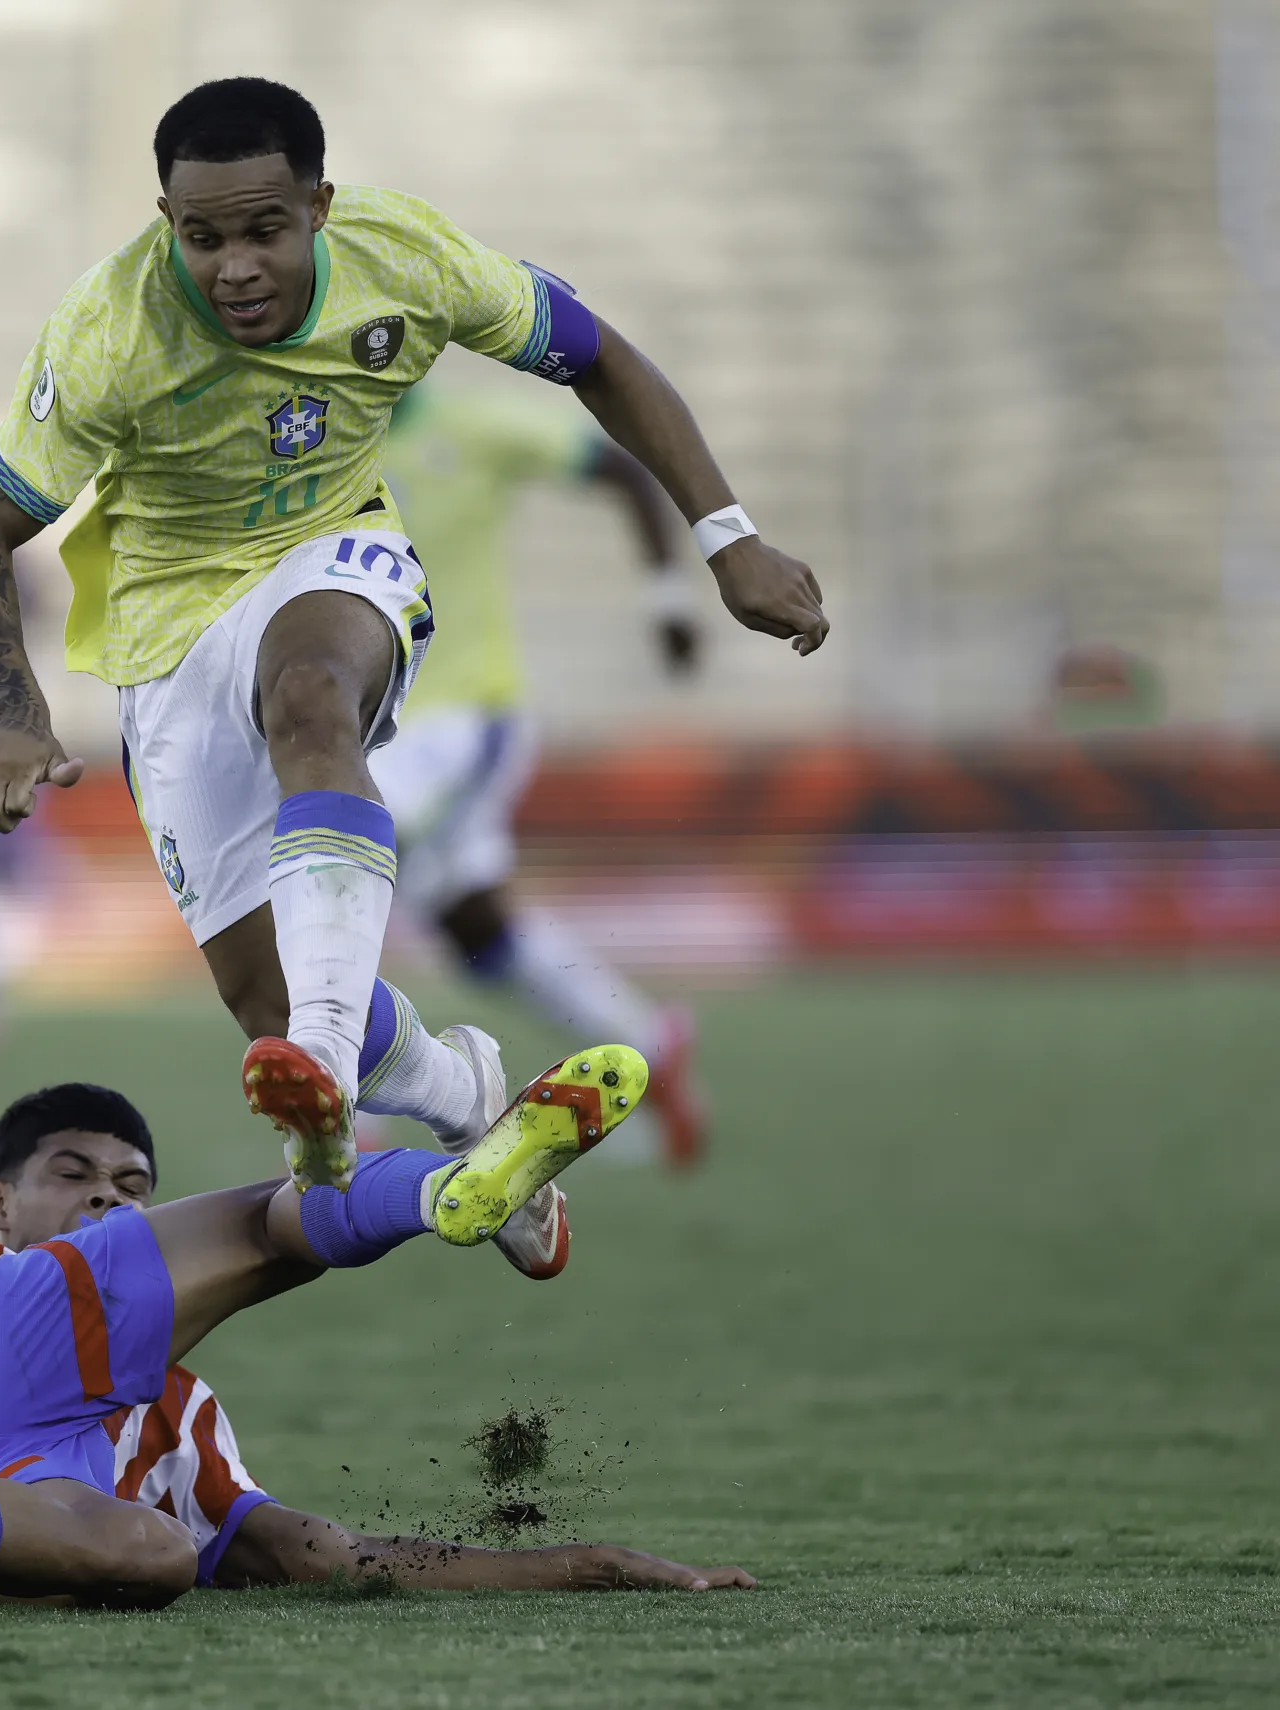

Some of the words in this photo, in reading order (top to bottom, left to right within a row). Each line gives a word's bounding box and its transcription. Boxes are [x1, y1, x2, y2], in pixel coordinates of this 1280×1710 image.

[369, 351, 388, 360] SUB20
[370, 360, 387, 368] 2023
[287, 421, 310, 434] CBF
